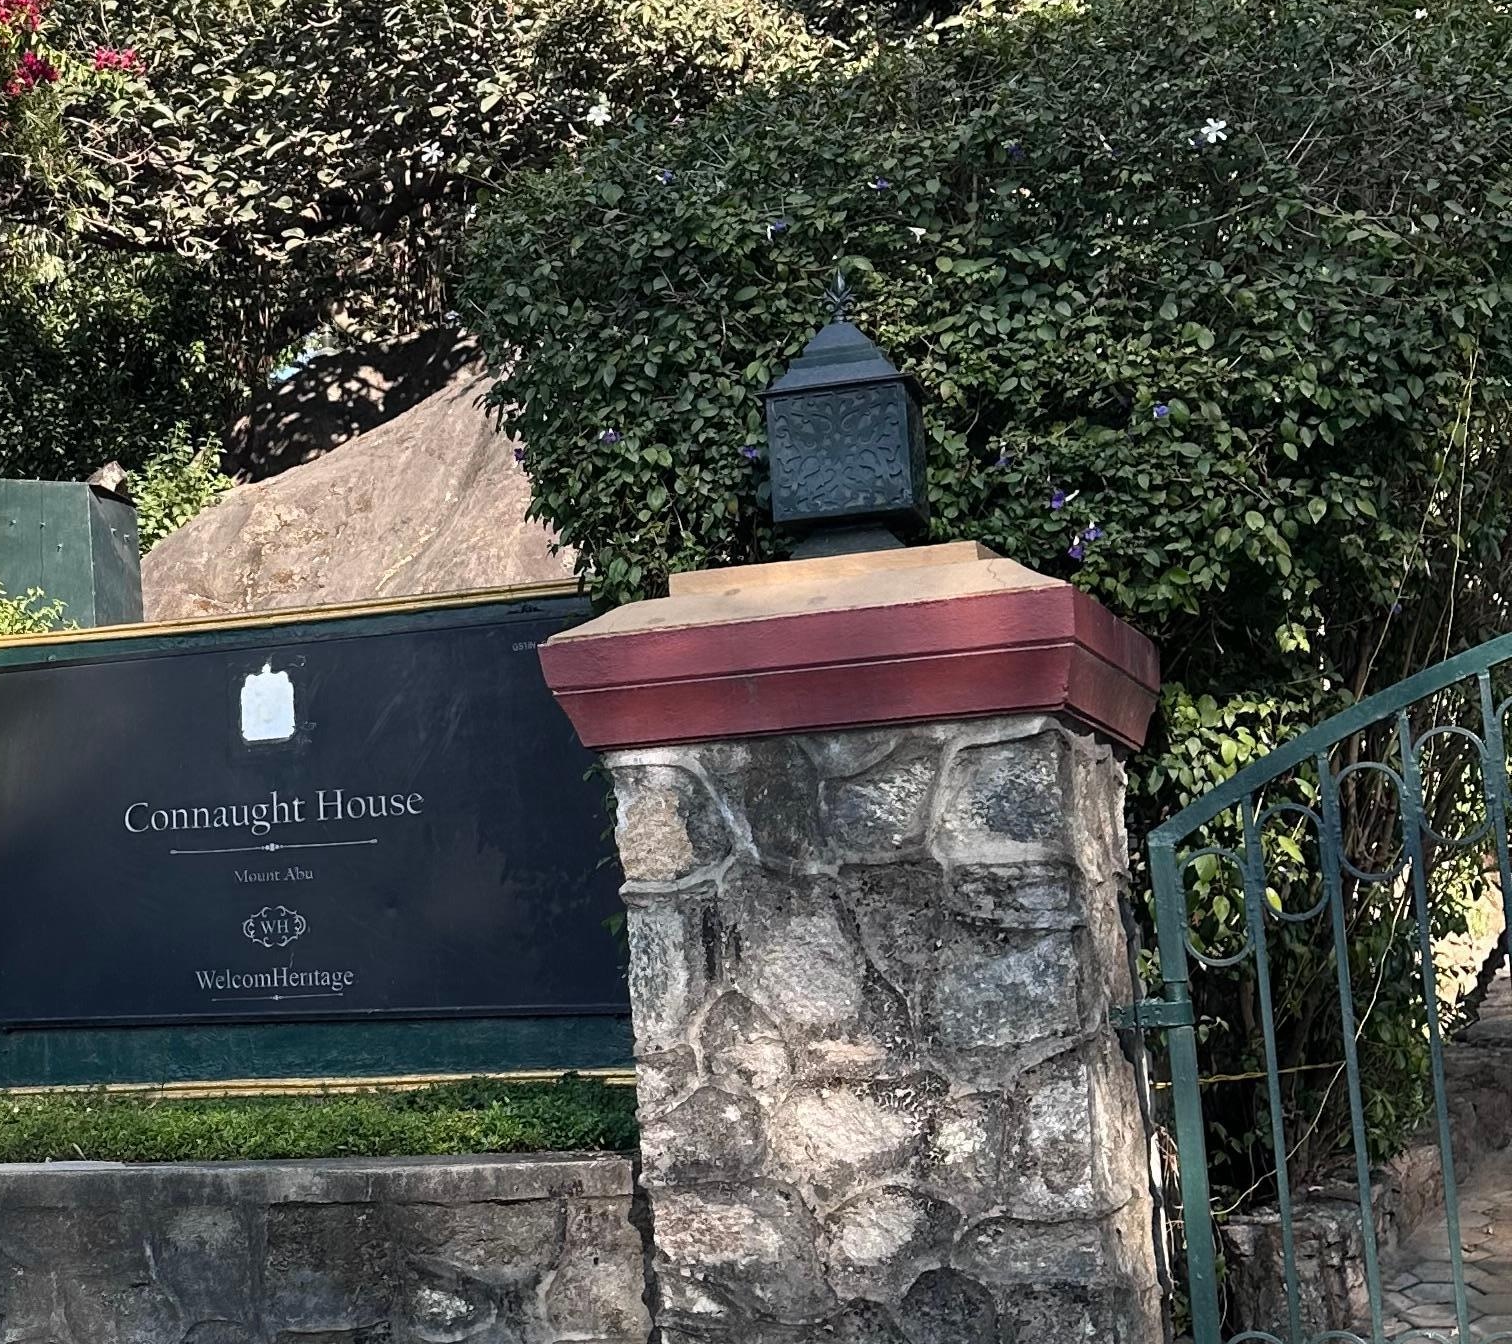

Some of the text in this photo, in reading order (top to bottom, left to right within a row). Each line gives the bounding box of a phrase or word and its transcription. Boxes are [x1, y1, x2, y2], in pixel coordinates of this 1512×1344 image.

[124, 788, 425, 836] Connaught House
[234, 866, 315, 884] Mount Abu
[260, 919, 289, 935] WH
[194, 967, 355, 991] WelcomHeritage
